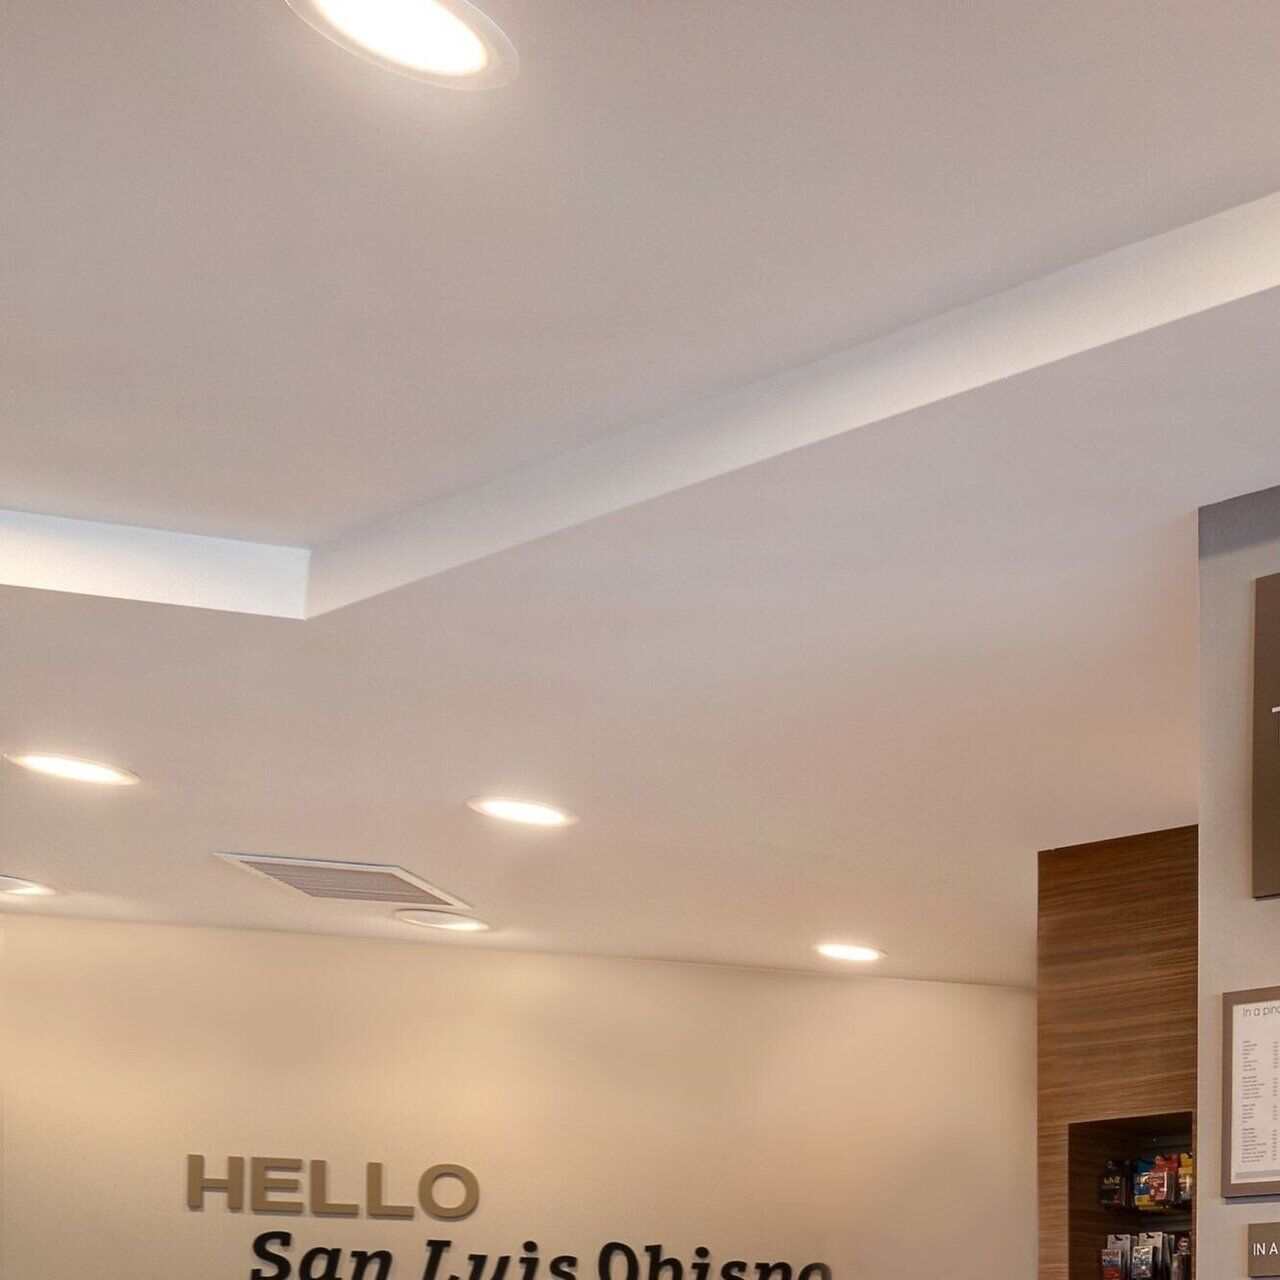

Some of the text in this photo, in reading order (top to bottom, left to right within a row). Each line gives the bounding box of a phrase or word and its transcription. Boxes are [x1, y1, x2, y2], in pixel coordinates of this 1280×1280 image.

[186, 1154, 480, 1220] HELLO
[1253, 1243, 1266, 1256] IN
[1269, 1242, 1278, 1255] A
